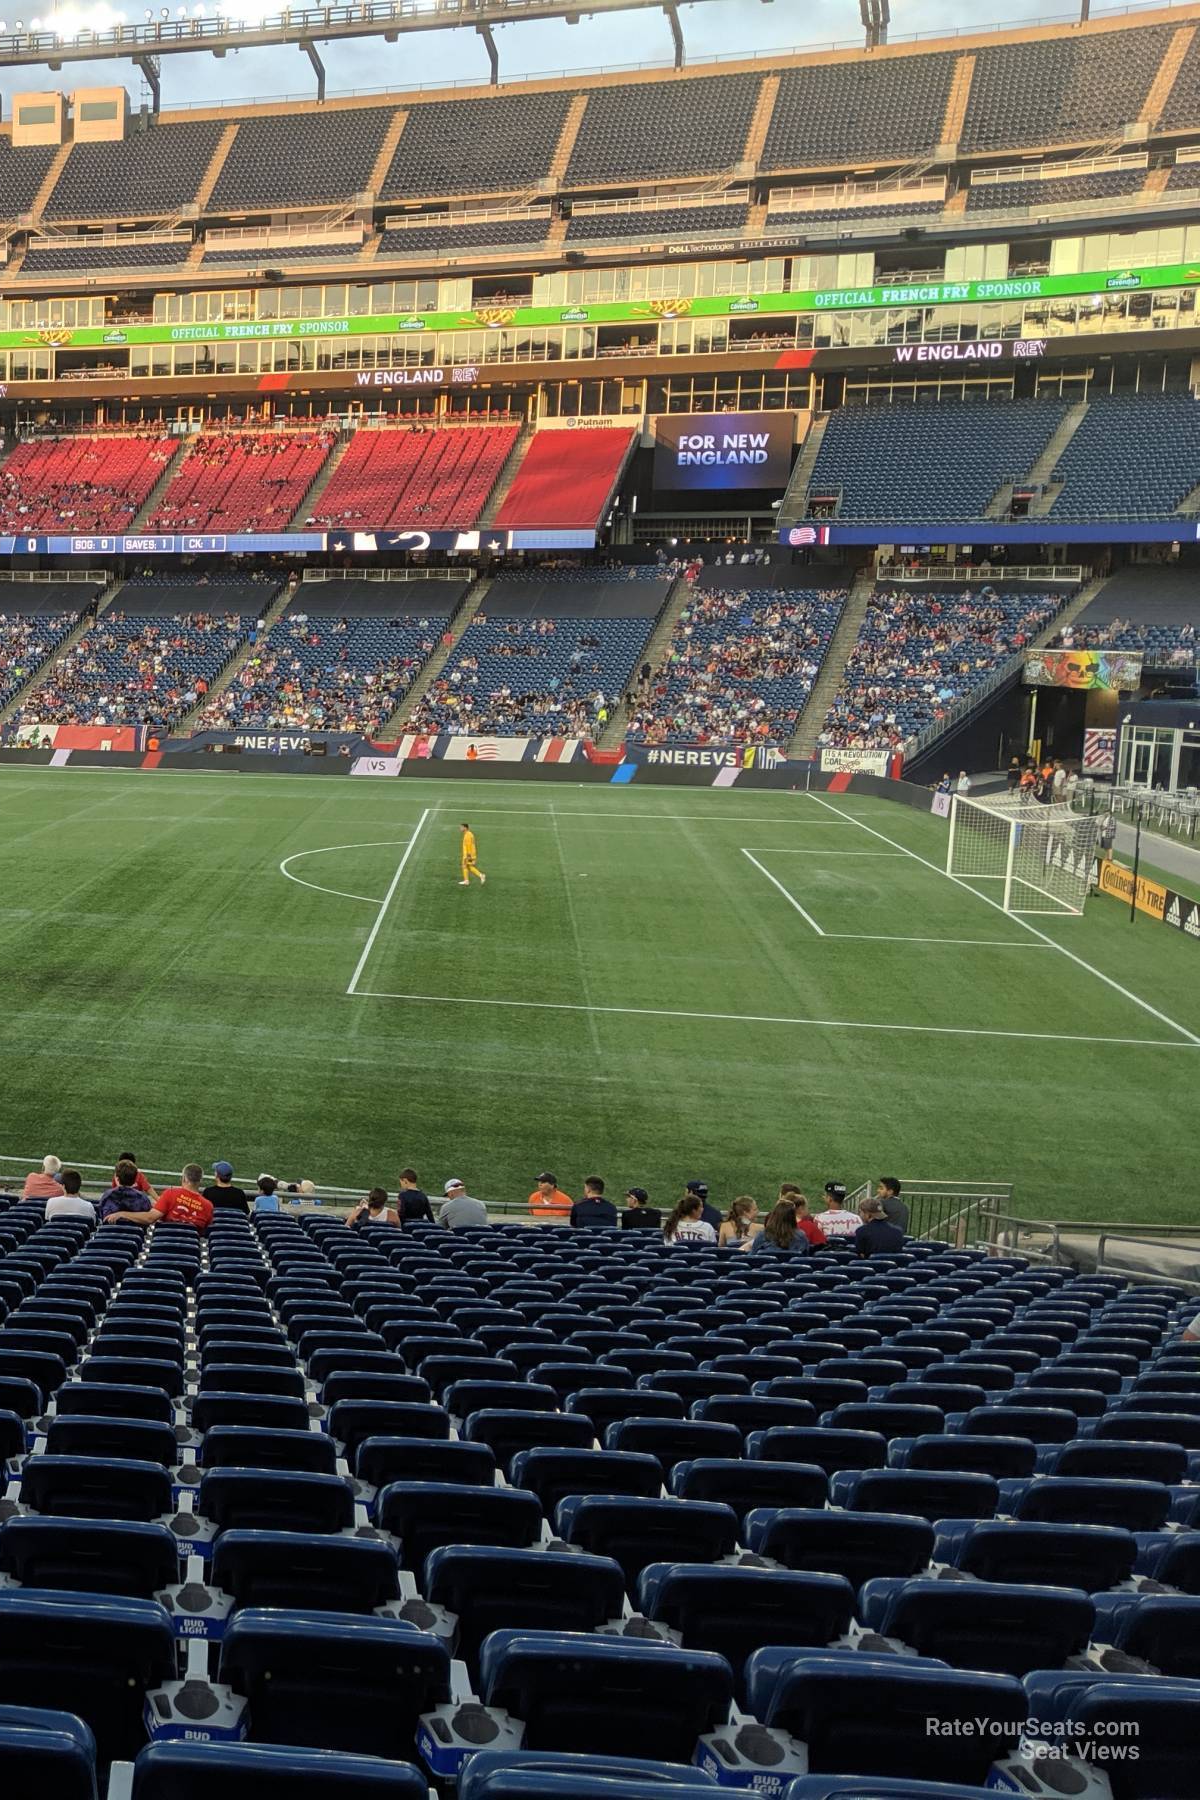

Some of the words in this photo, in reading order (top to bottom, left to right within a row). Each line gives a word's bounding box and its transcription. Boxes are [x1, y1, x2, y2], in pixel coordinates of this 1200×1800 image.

[1108, 277, 1140, 287] Cavendish
[815, 291, 875, 306] OFFICIAL
[881, 288, 939, 302] FRENCH
[943, 286, 970, 300] FRY
[976, 281, 1041, 298] SPONSOR
[730, 302, 758, 311] Cavendish
[171, 327, 219, 339] OFFICIAL
[225, 325, 271, 337] FRENCH
[273, 323, 294, 335] FRY
[299, 321, 349, 333] SPONSOR
[917, 343, 1002, 361] ENGLAND
[374, 369, 444, 384] ENGLAND
[577, 418, 613, 427] Putnam
[679, 435, 715, 449] FOR
[723, 433, 770, 449] NEW
[677, 450, 768, 466] ENGLAND
[28, 539, 37, 551] 0
[75, 540, 96, 550] SOG:
[101, 539, 107, 549] 0
[126, 540, 157, 550] SAVES:
[189, 539, 204, 549] CK:
[647, 749, 737, 766] #NEREVS
[1147, 890, 1165, 911] TIRE
[675, 1231, 705, 1241] BETTS
[183, 1619, 205, 1627] BUD
[179, 1626, 208, 1635] LIGHT
[184, 1730, 211, 1741] BUD
[752, 1774, 781, 1786] BUD
